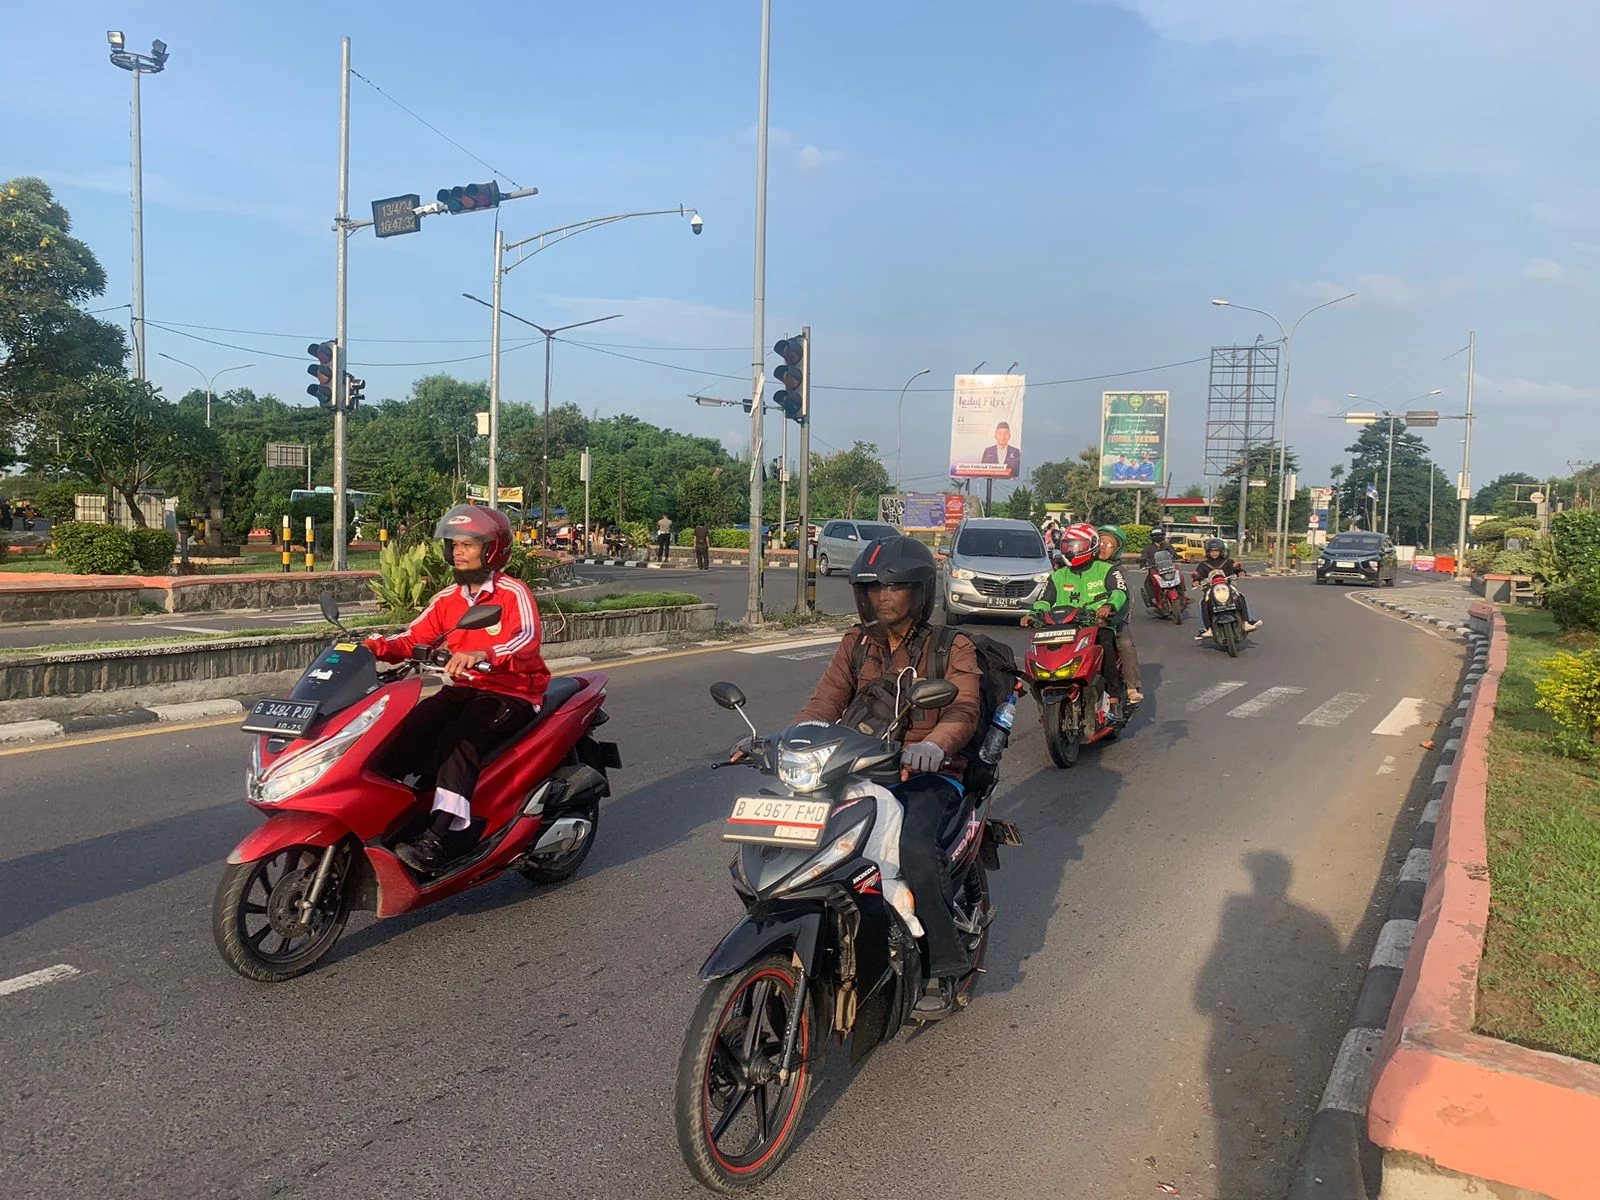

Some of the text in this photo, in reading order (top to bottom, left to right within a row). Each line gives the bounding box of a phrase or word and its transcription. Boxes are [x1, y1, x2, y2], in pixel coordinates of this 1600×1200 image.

[255, 702, 313, 719] B 3484 PJD
[736, 801, 826, 822] B 4967 FMD
[852, 865, 877, 884] HONDA
